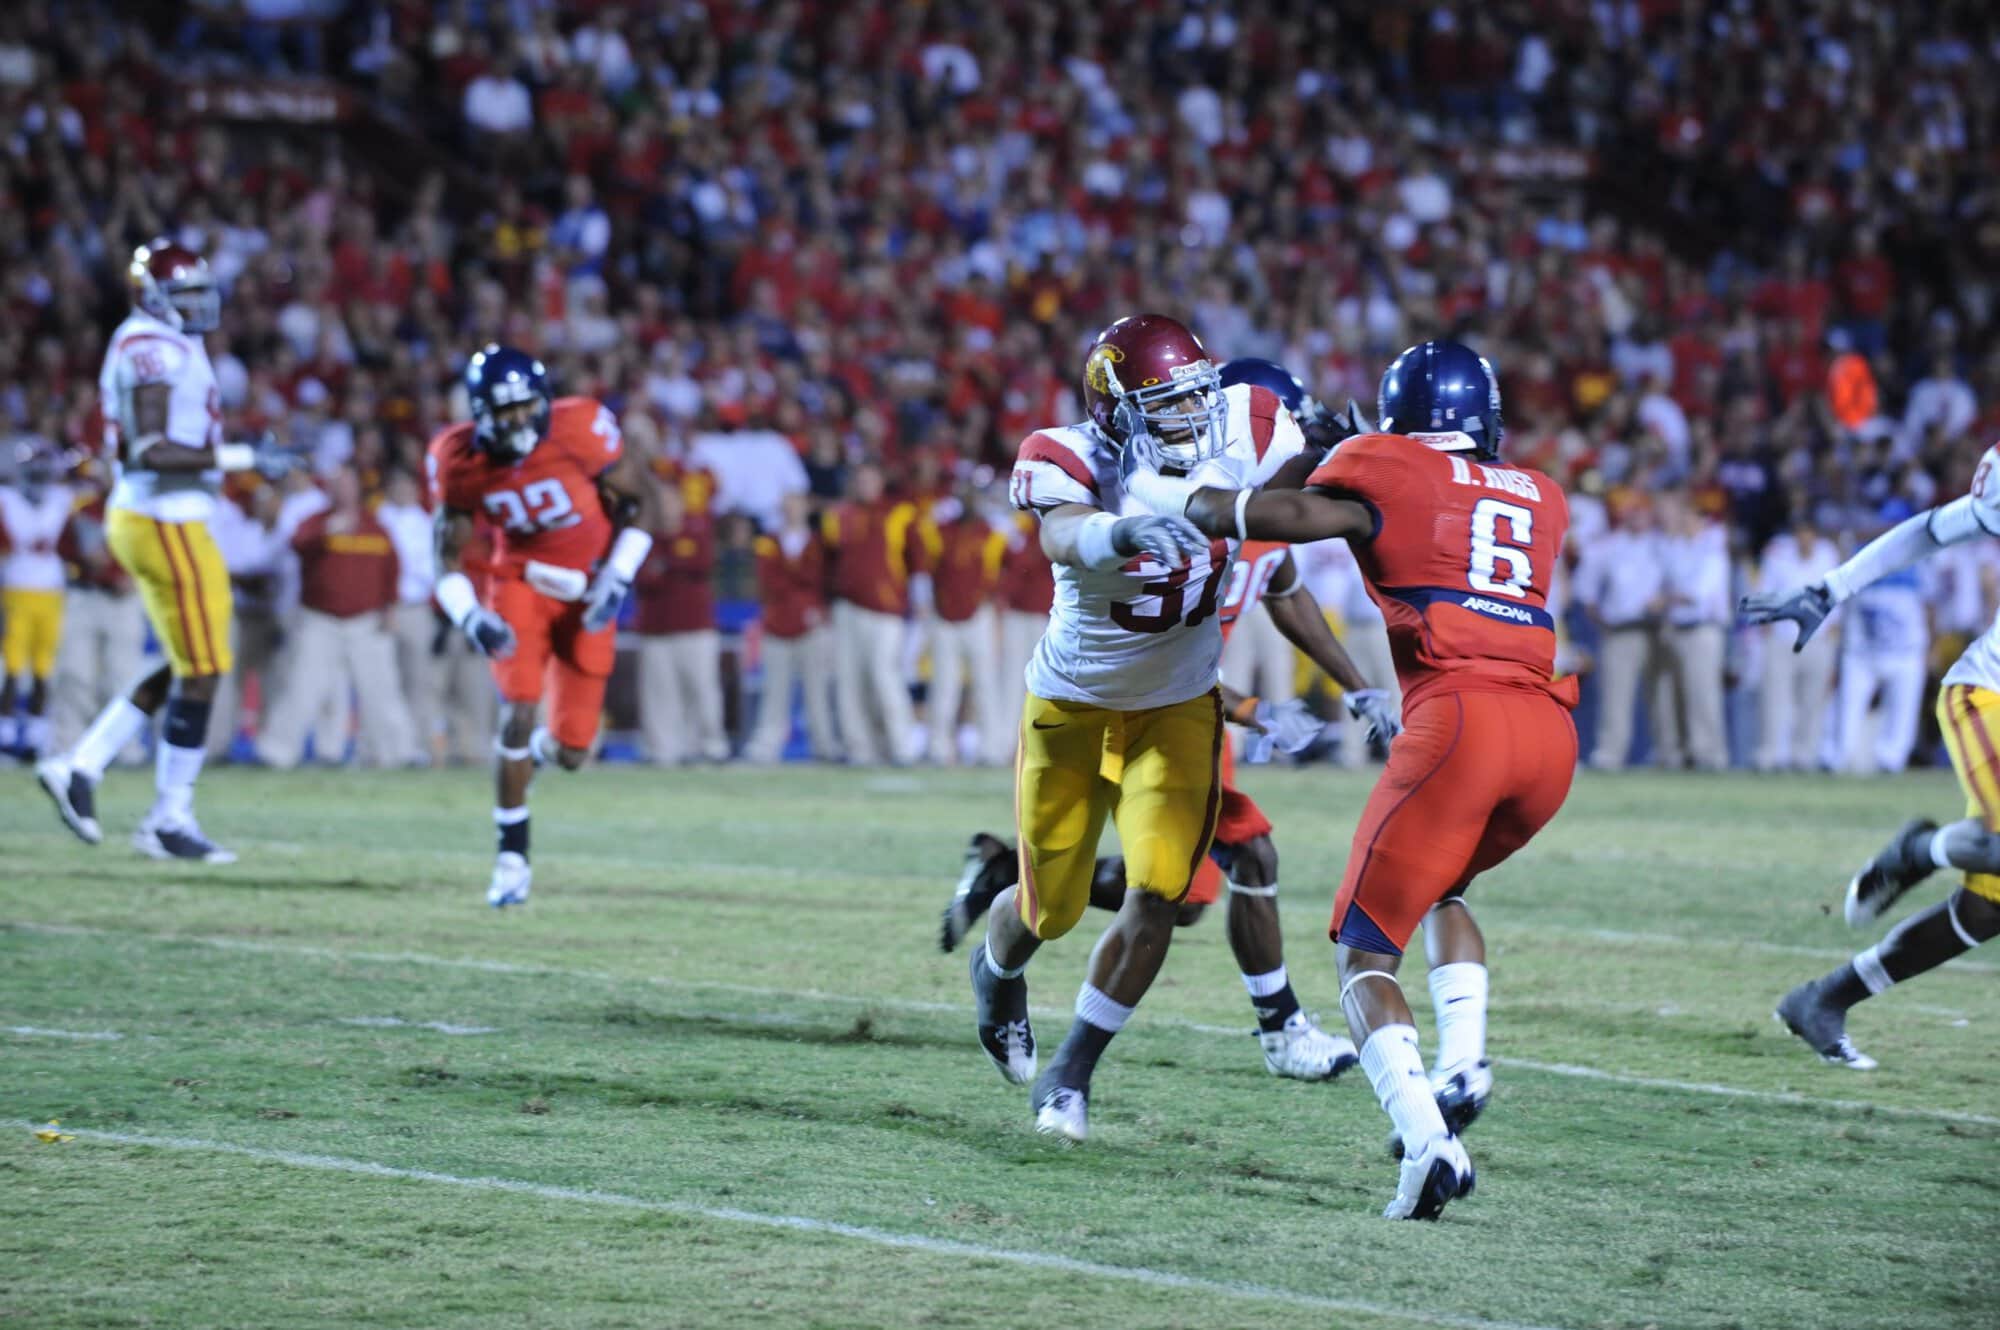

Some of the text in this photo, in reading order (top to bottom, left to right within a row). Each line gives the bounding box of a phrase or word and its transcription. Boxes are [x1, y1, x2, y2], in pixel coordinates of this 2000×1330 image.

[1446, 455, 1481, 486] D.
[483, 478, 582, 533] 32
[1466, 497, 1533, 598] 6
[1461, 597, 1534, 625] ARIZONA
